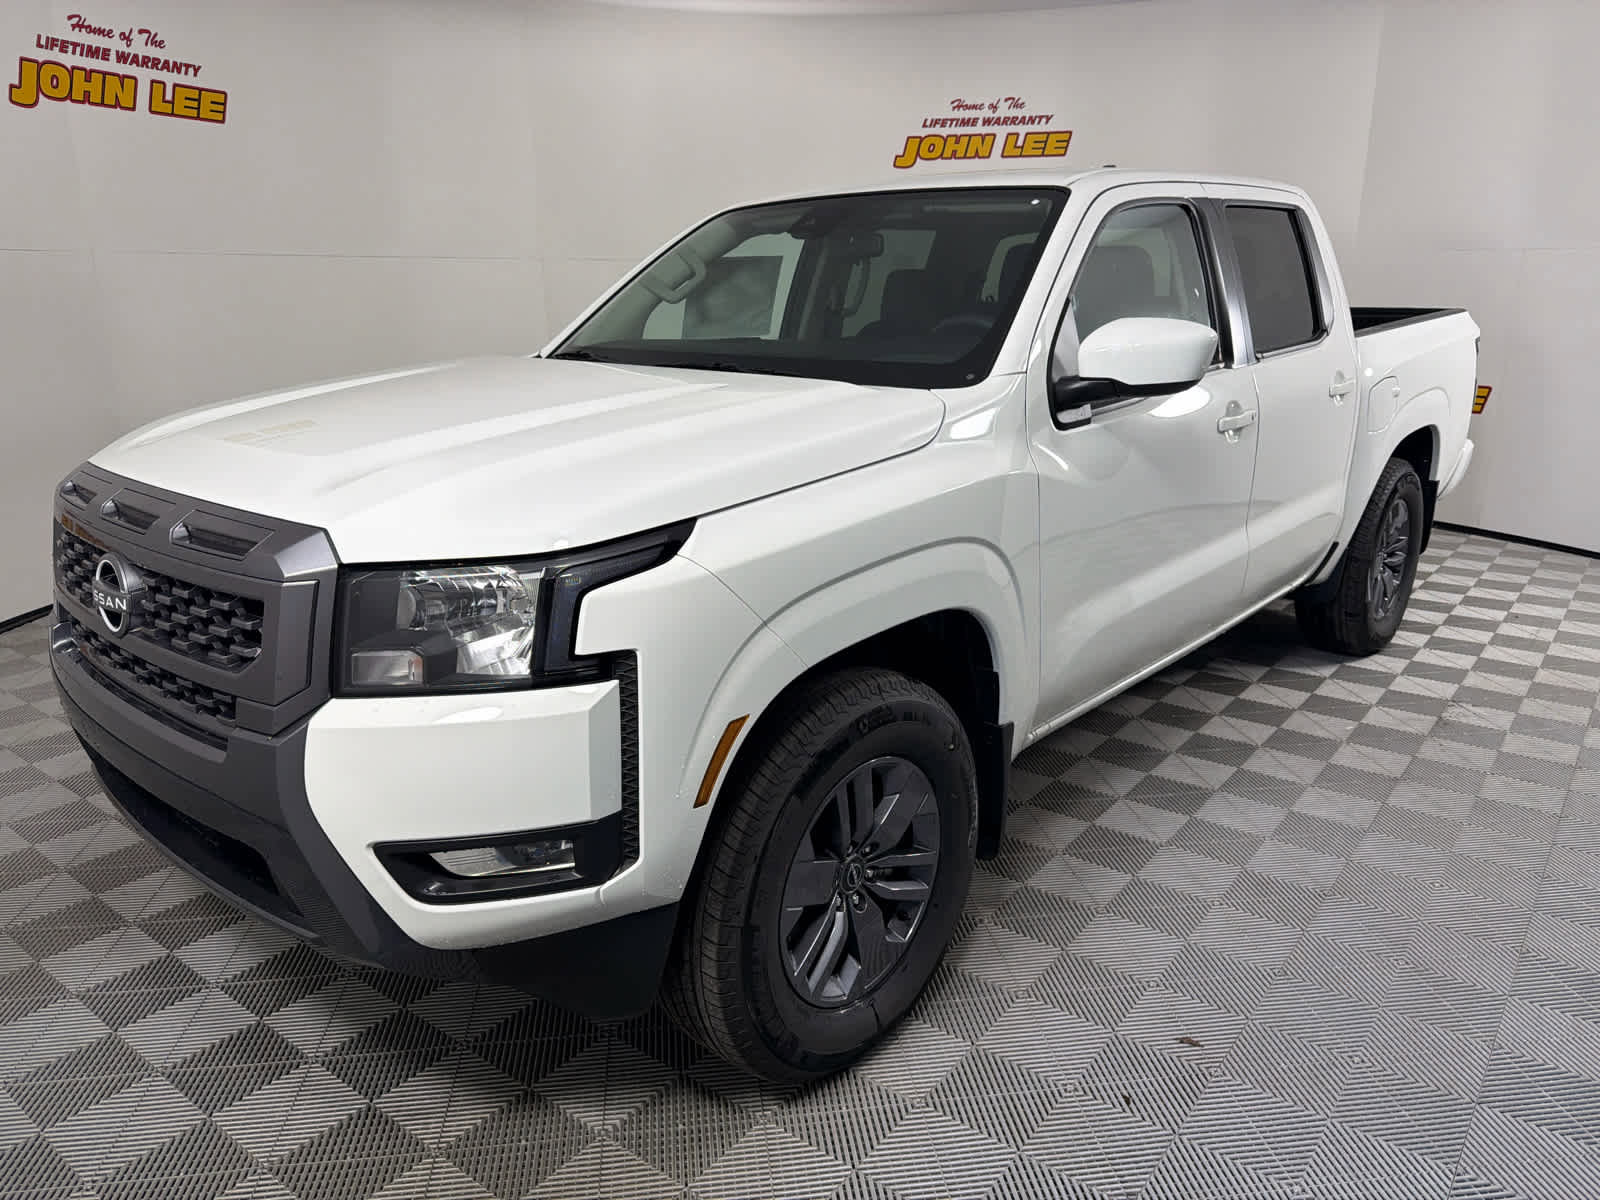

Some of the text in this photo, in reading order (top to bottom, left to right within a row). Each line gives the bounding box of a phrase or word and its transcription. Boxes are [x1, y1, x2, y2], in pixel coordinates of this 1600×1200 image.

[67, 14, 167, 49] Home of The
[36, 34, 202, 77] LIFETIME WARRANTY
[9, 56, 228, 124] JOHN LEE
[950, 96, 1027, 114] Home of The
[922, 114, 1053, 129] LIFETIME WARRANTY
[893, 131, 1073, 169] JOHN LEE
[93, 589, 127, 610] SSAN
